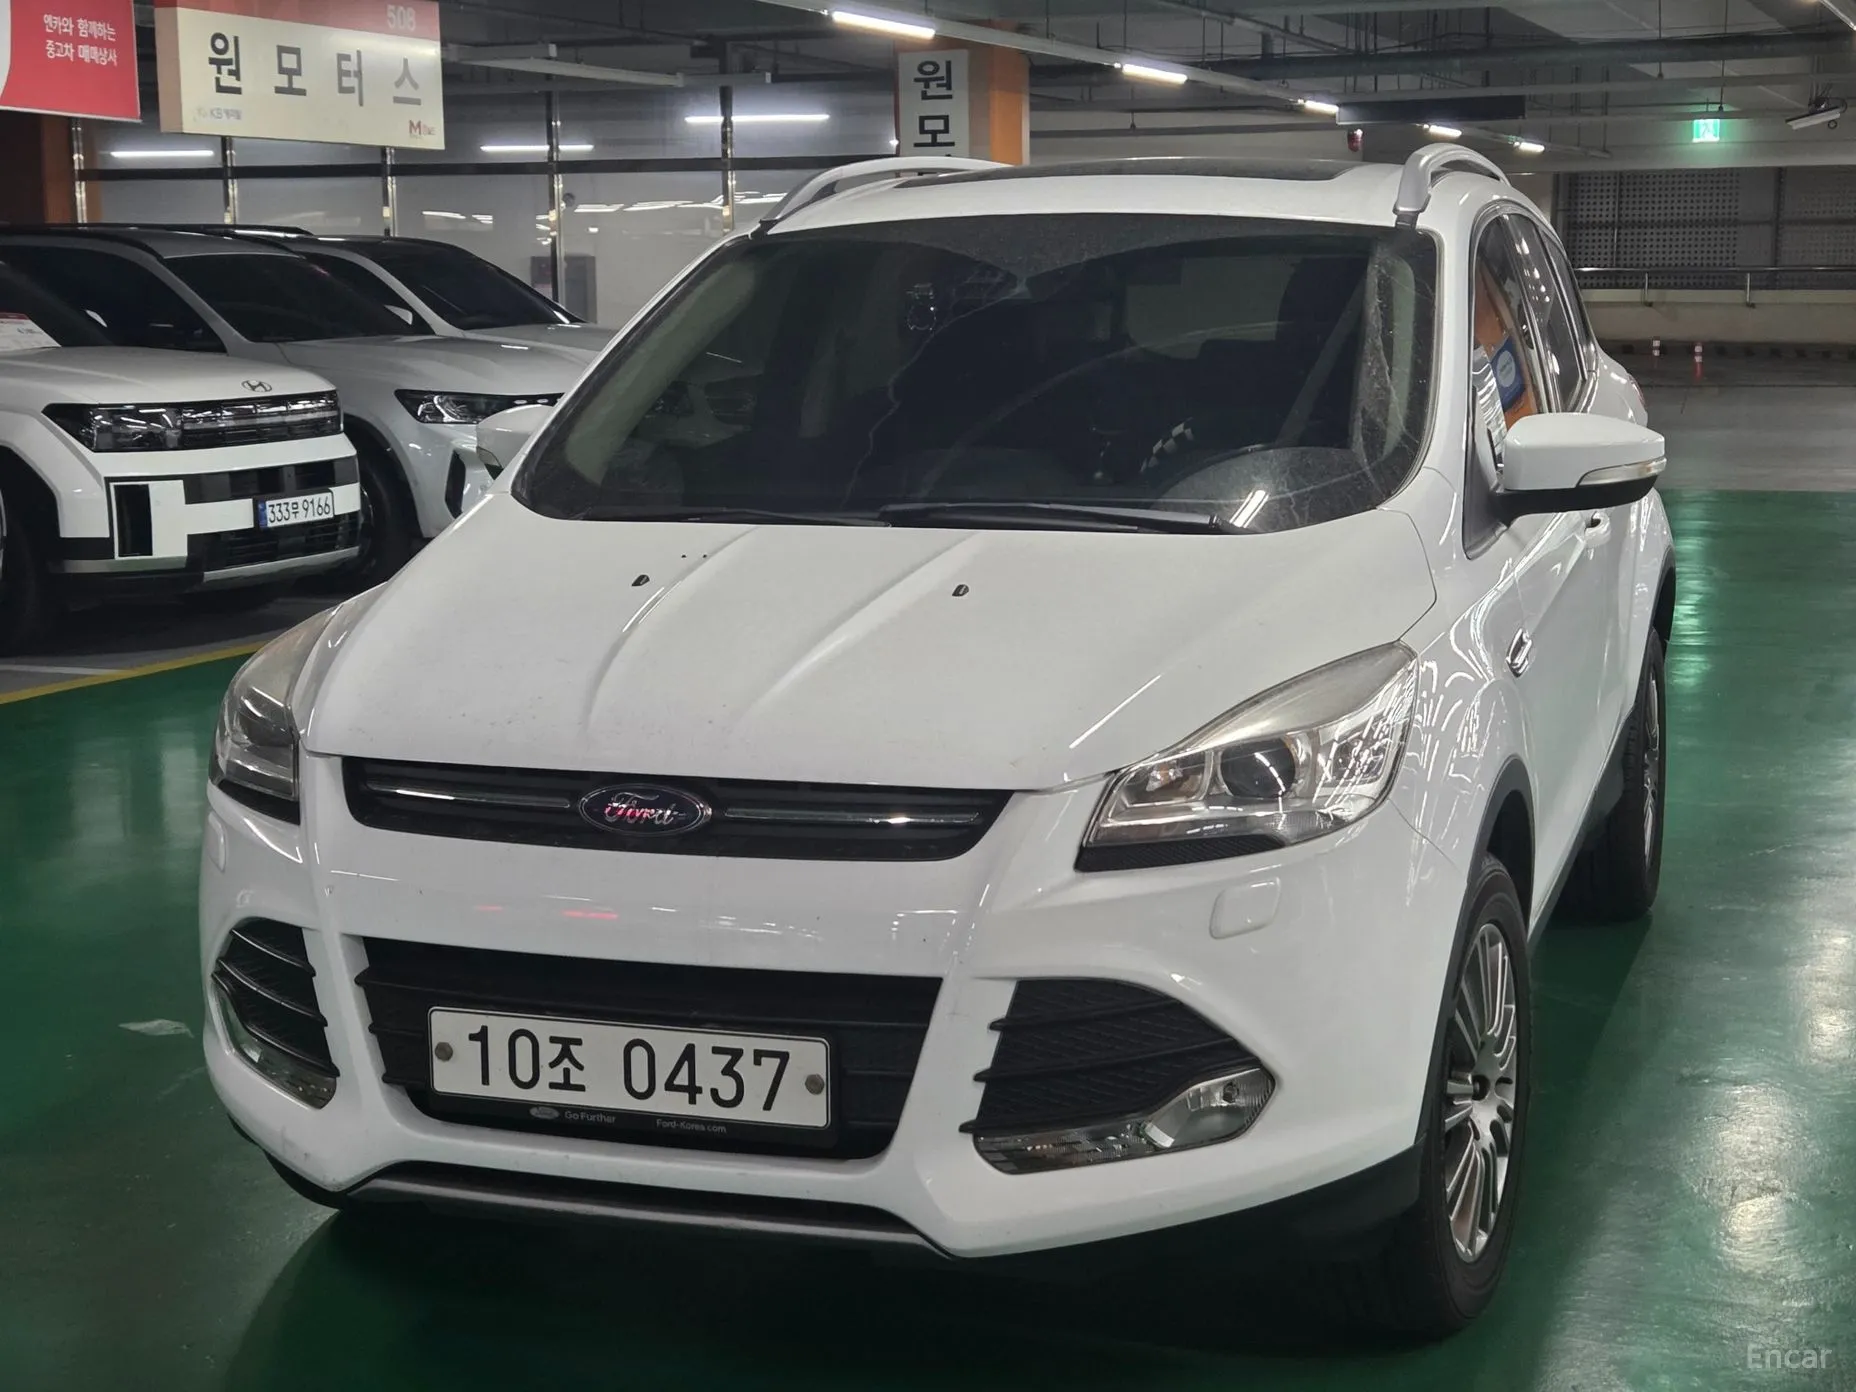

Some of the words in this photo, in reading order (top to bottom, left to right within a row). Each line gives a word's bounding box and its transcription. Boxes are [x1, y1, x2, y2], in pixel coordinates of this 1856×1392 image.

[43, 13, 75, 36] 엔카와
[77, 17, 117, 42] 함께하는
[386, 4, 416, 32] 508
[45, 40, 75, 62] 중고차
[77, 44, 118, 67] 매매상사
[913, 60, 956, 157] 원모
[268, 502, 299, 523] 333무
[302, 496, 331, 519] 9166
[604, 791, 675, 825] Ford
[468, 1025, 586, 1092] 10조
[623, 1038, 790, 1111] 0437
[564, 1108, 580, 1120] Go
[581, 1110, 616, 1124] Further
